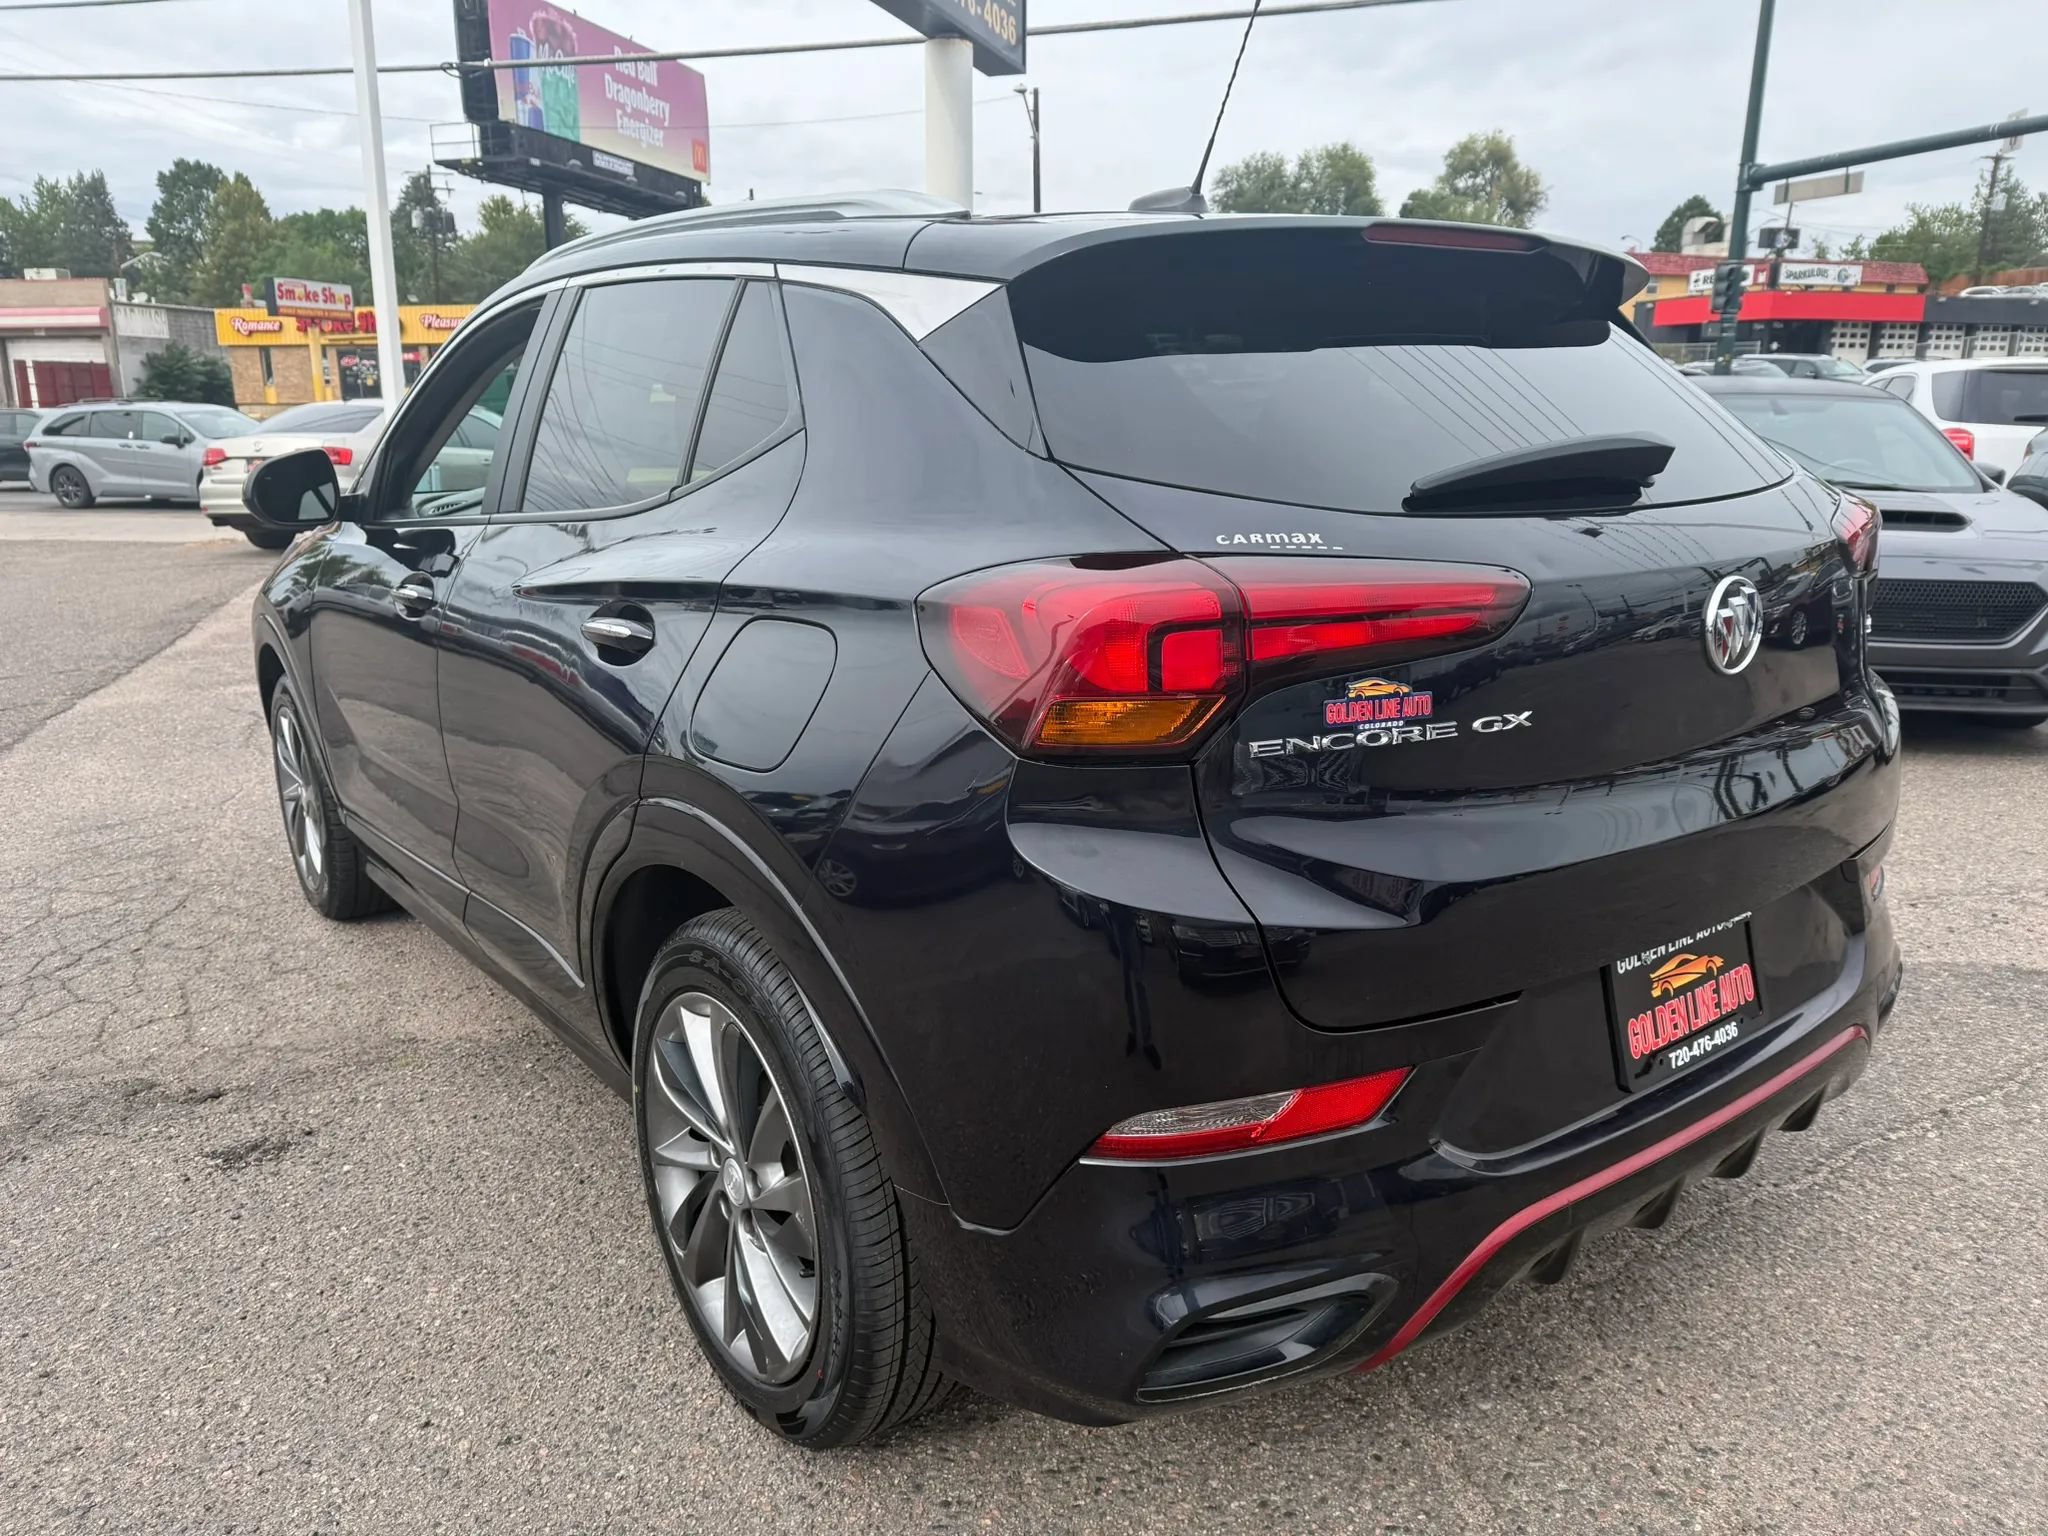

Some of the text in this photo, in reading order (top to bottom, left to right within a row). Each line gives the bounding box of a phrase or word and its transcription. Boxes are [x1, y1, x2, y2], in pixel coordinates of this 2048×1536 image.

[604, 72, 670, 127] Dragonberry
[615, 108, 664, 148] Energizer
[277, 283, 351, 311] Smoke Shop
[231, 317, 281, 336] Romance
[1325, 694, 1432, 724] GOLDEN LINE AUTO
[1358, 720, 1404, 730] COLORADO
[1249, 710, 1533, 759] ENCORE GX
[1628, 963, 1756, 1060] GOLDEN LINE AUTO
[1668, 1021, 1738, 1069] 720-476-4036
